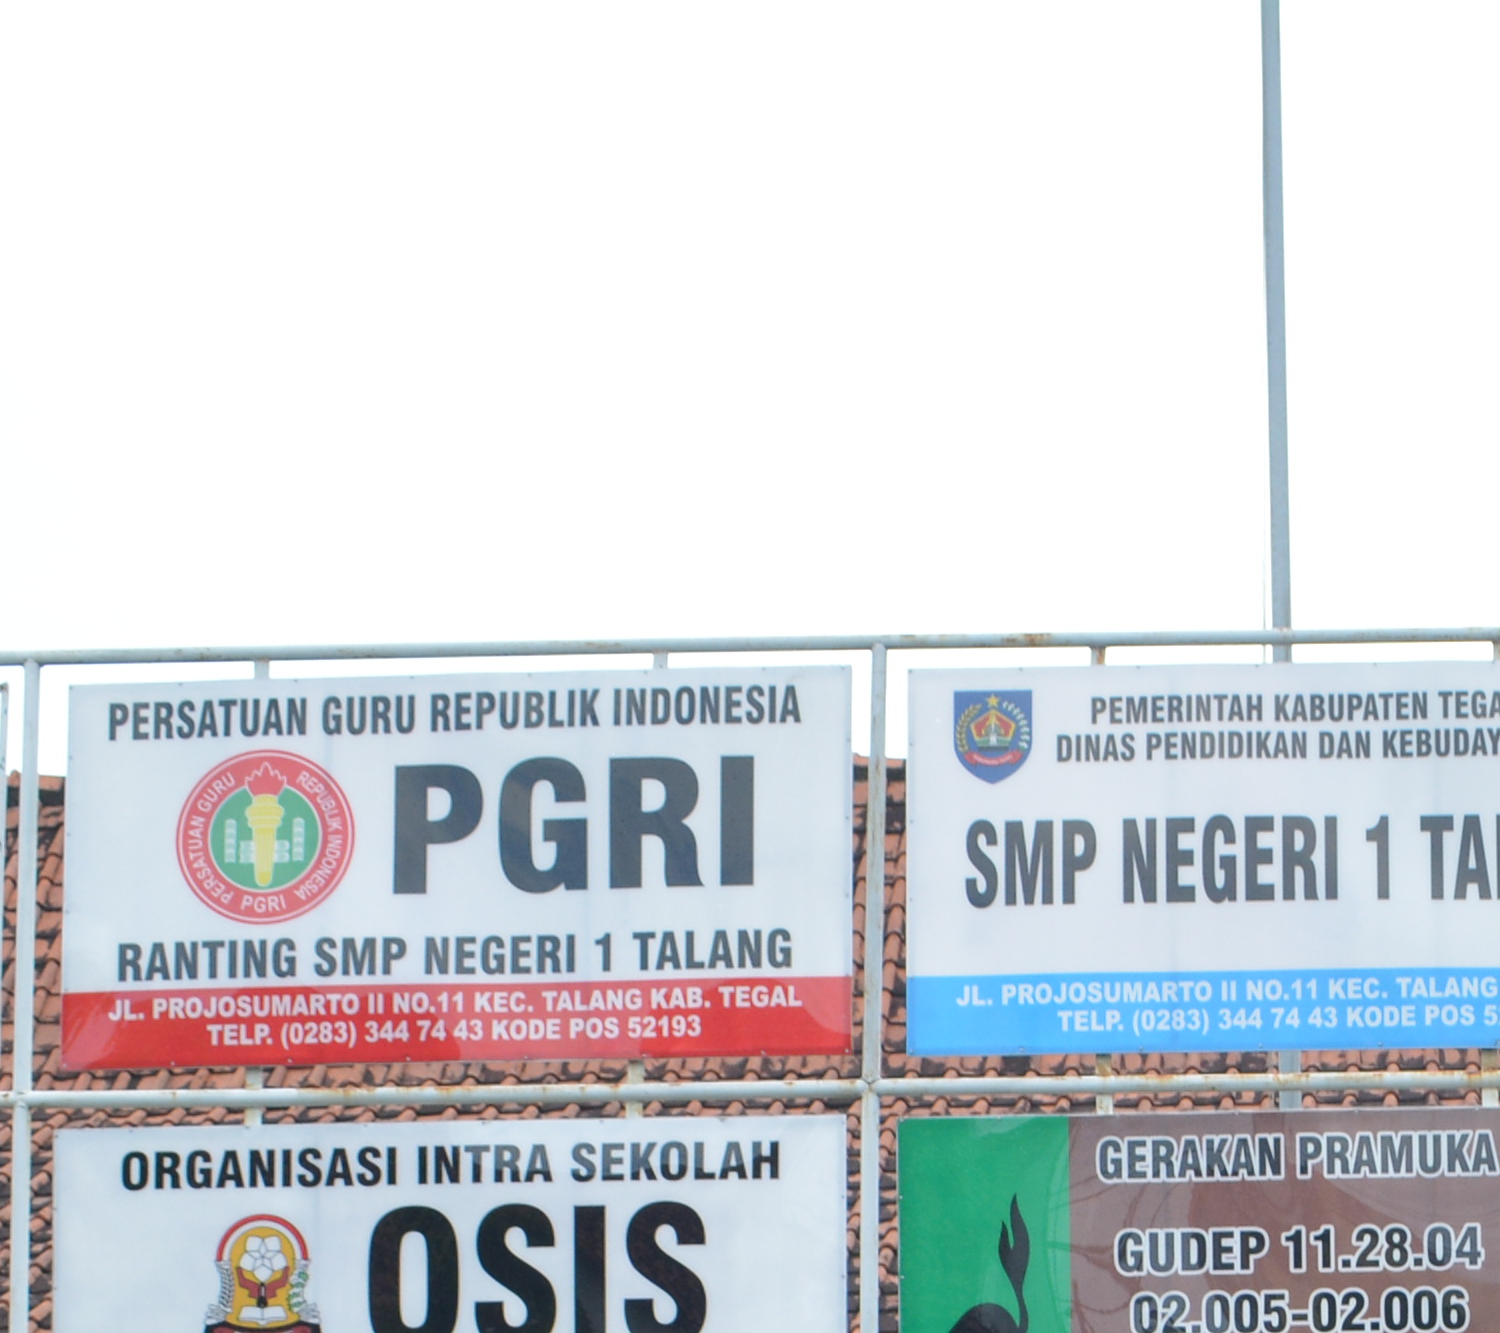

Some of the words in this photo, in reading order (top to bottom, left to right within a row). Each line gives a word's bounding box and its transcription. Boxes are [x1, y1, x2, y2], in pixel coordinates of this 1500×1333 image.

[109, 698, 306, 740] PERSATUAN
[323, 695, 414, 735] GURU
[431, 689, 599, 732] REPUBLIK
[614, 685, 801, 726] INDONESIA
[1092, 695, 1262, 724] PEMERINTAH
[1275, 692, 1427, 722] KABUPATEN
[1057, 733, 1135, 762] DINAS
[1147, 732, 1306, 760] PENDIDIKAN
[1319, 731, 1370, 758] DAN
[197, 772, 236, 813] GURU
[296, 771, 343, 831] REPUBLIK
[394, 756, 754, 894] PGRI
[188, 815, 234, 904] PERSATUAN
[294, 834, 343, 900] INDONESIA
[966, 820, 1096, 908] SMP
[1123, 815, 1338, 903] NEGERI
[1366, 816, 1389, 900] 1
[241, 894, 287, 913] PGRI
[119, 938, 296, 981] RANTING
[314, 937, 406, 977] SMP
[425, 935, 575, 974] NEGERI
[596, 933, 610, 971] 1
[633, 929, 791, 970] TALANG
[108, 999, 144, 1021] JL.
[153, 993, 359, 1019] PROJOSUMARTO
[369, 993, 383, 1013] II
[394, 992, 463, 1013] NO.11
[475, 992, 533, 1012] KEC.
[542, 989, 642, 1011] TALANG
[651, 987, 710, 1009] KAB.
[719, 985, 802, 1007] TEGAL
[122, 1147, 396, 1190] ORGANISASI
[418, 1145, 552, 1184] INTRA
[571, 1141, 779, 1182] SEKOLAH
[1099, 1135, 1281, 1181] GERAKAN
[1298, 1130, 1499, 1178] PRAMUKA
[1117, 1228, 1265, 1276] GUDEP
[1284, 1224, 1482, 1271] 11.28.04
